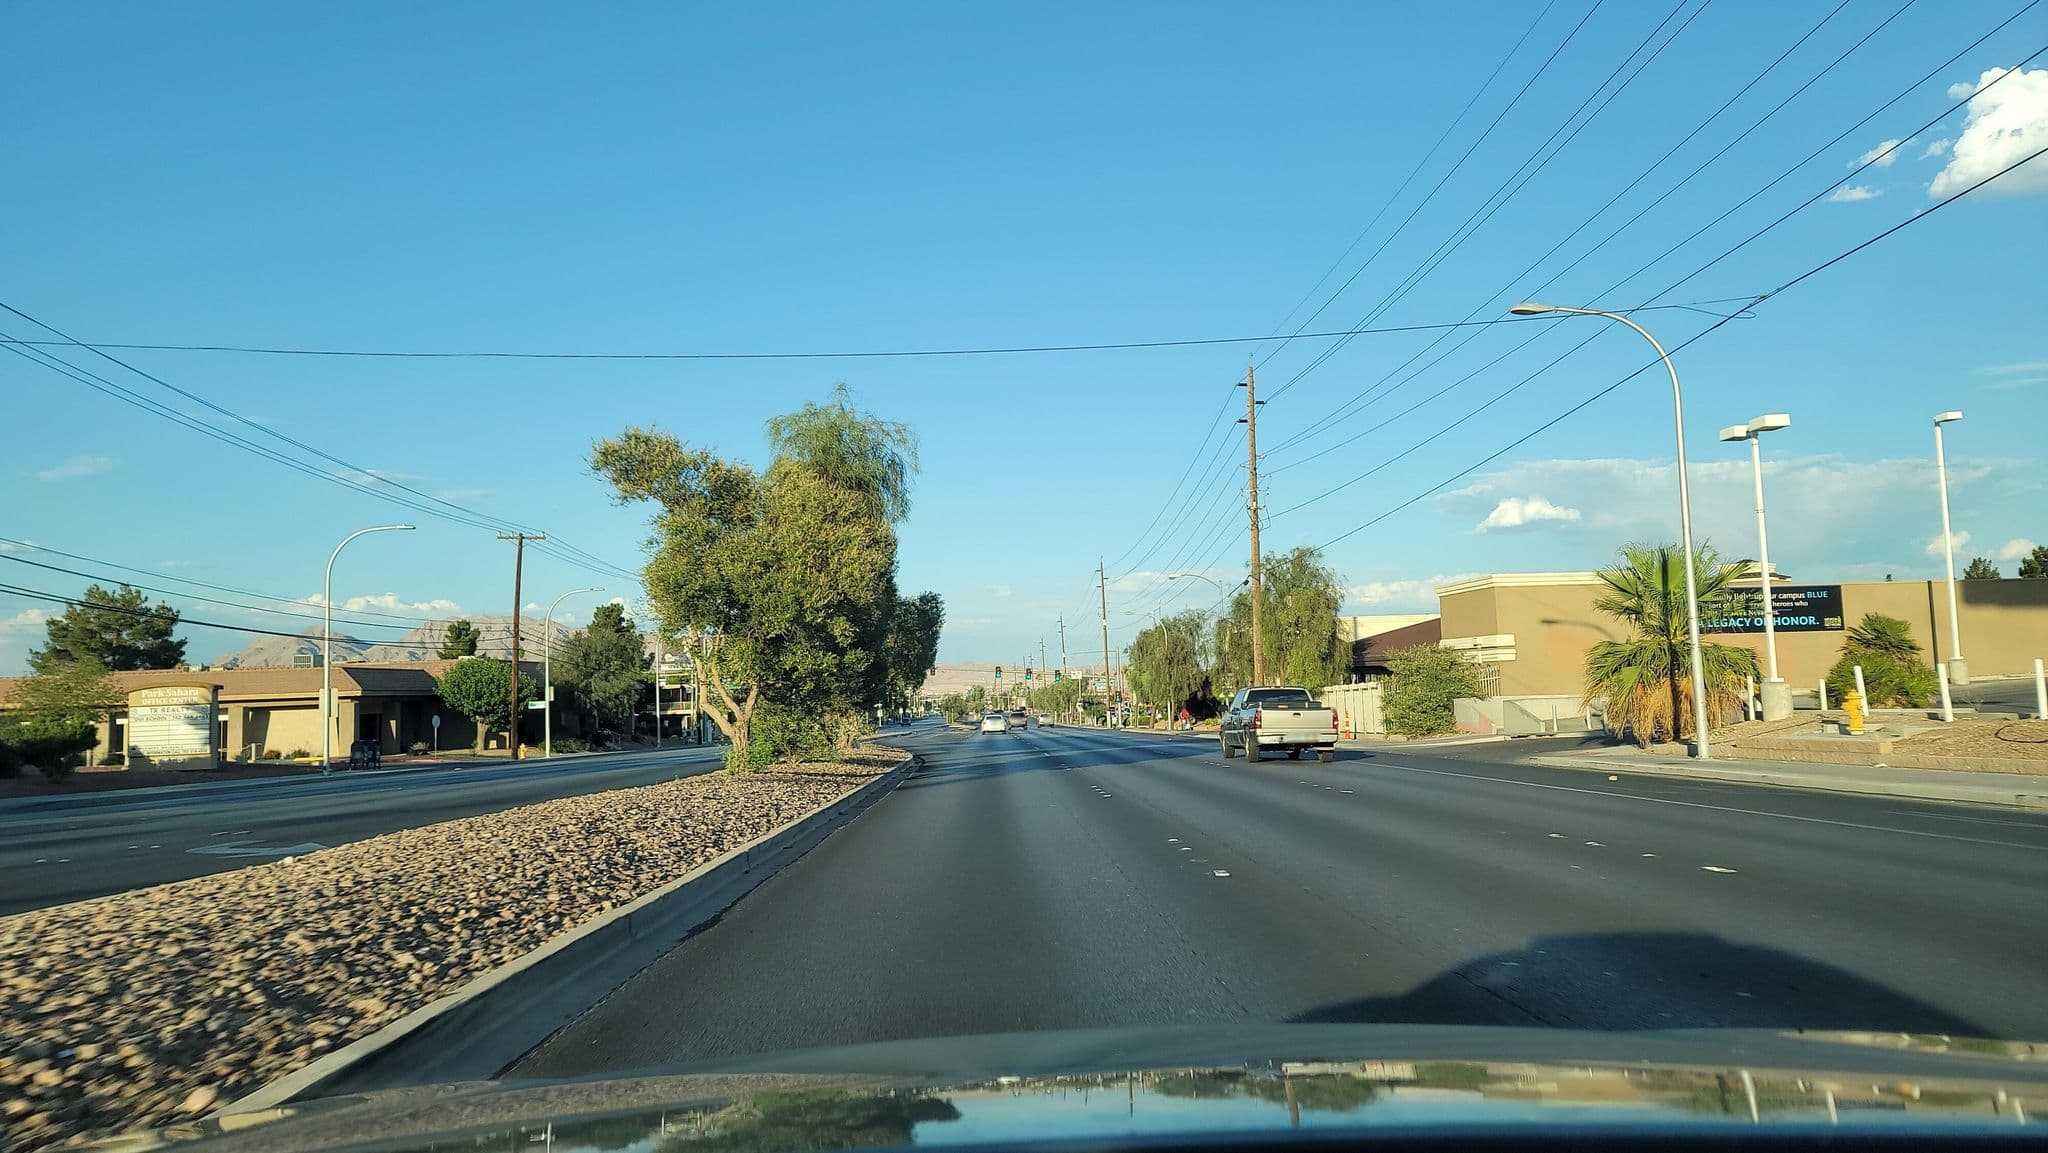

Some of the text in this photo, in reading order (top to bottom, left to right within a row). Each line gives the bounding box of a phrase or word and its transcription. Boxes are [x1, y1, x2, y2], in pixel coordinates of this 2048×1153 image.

[1778, 592, 1806, 600] campus
[1708, 617, 1751, 628] LEGACY
[1772, 615, 1820, 626] HONOR.
[142, 688, 199, 698] Park Sahara
